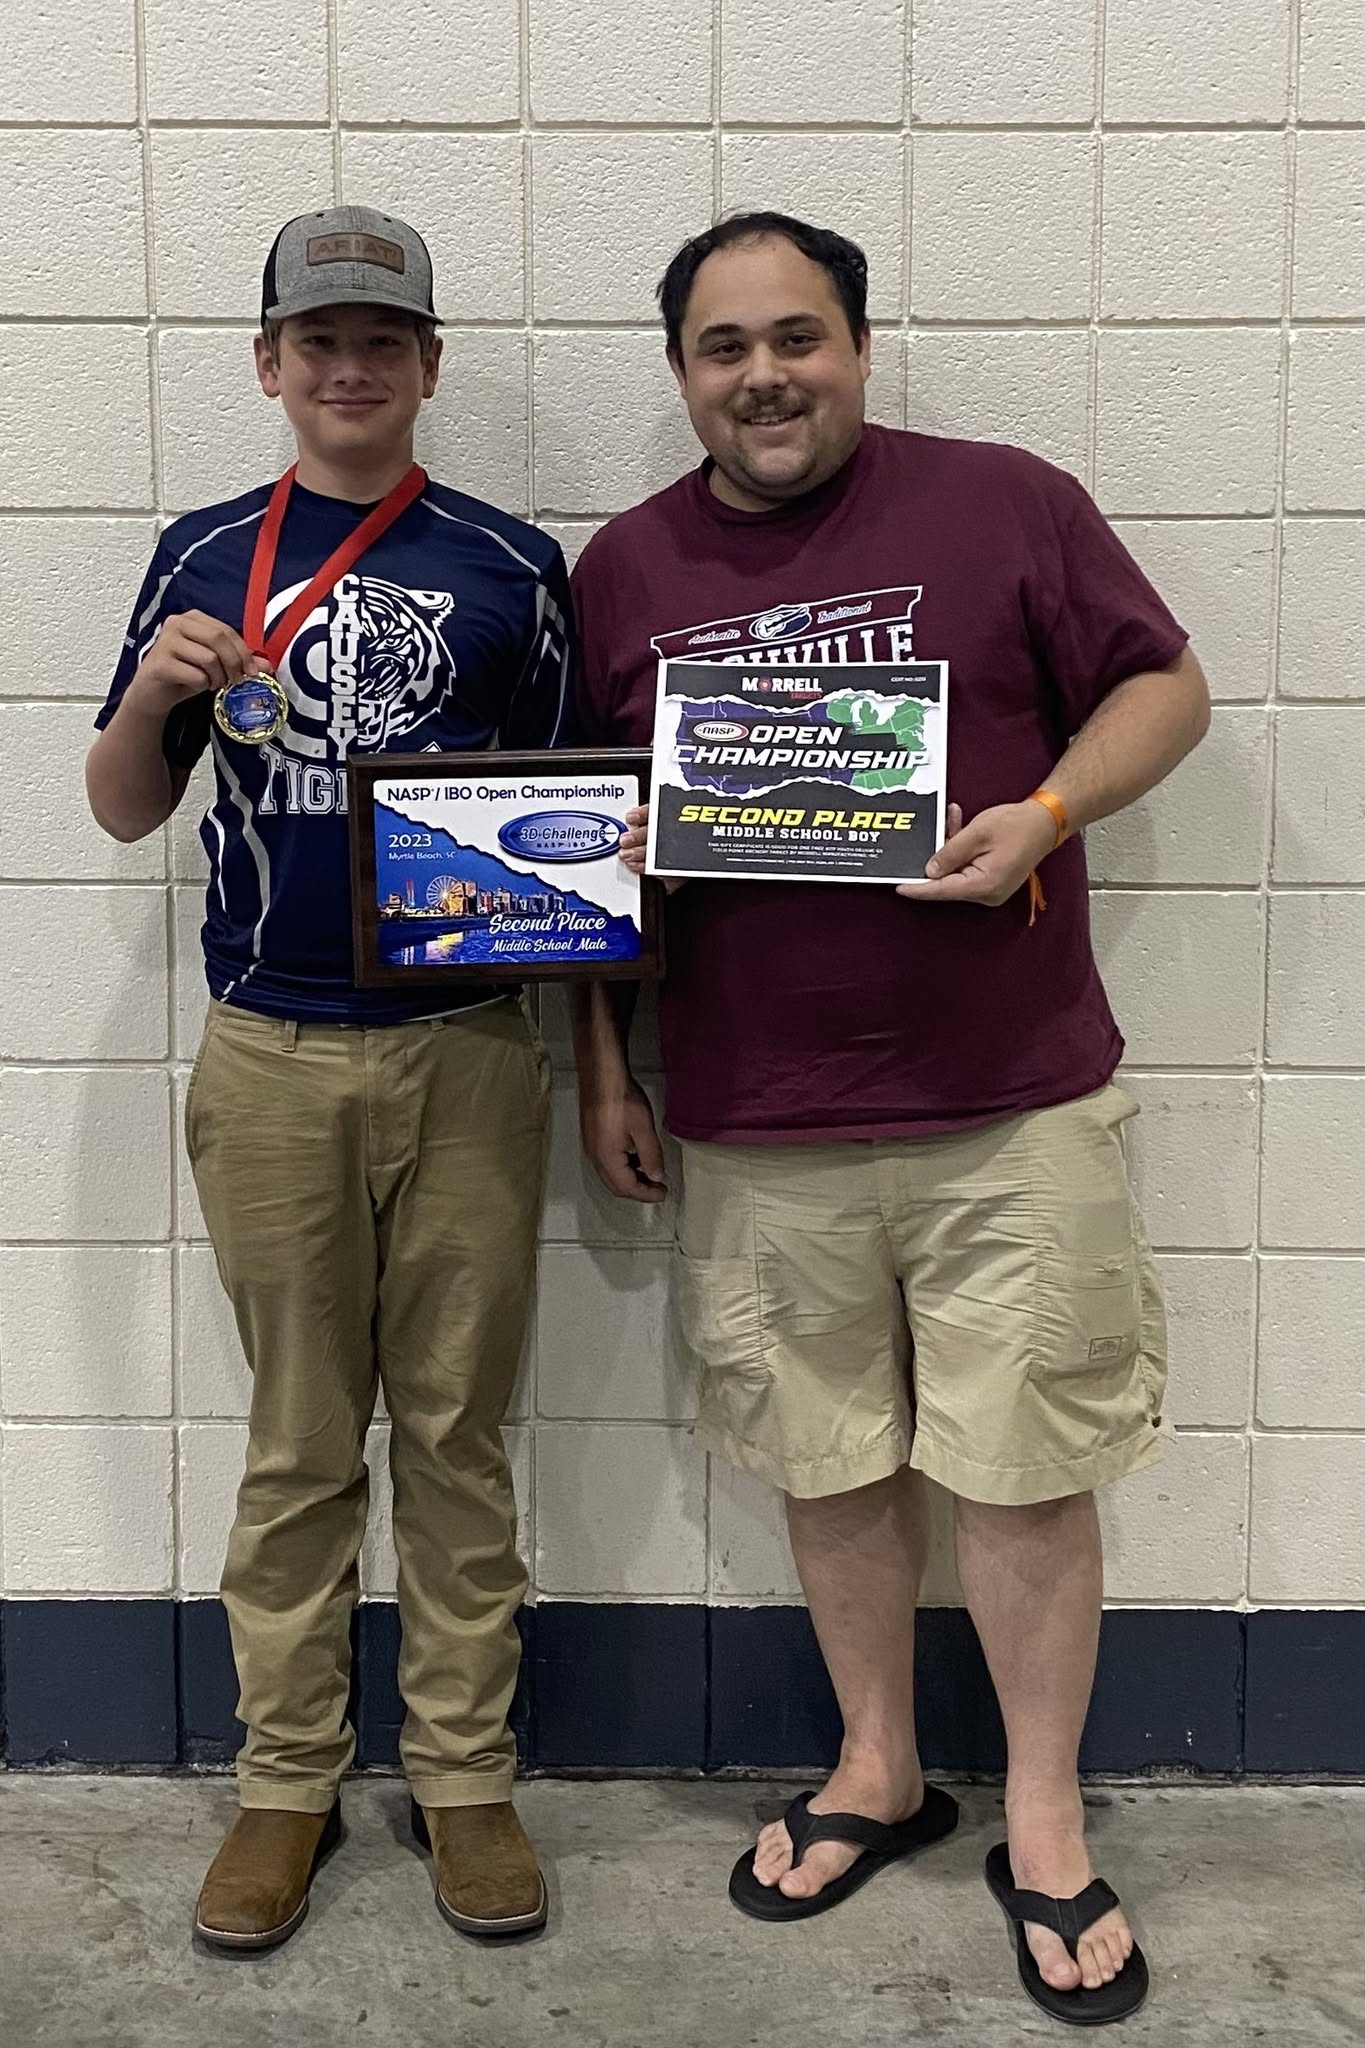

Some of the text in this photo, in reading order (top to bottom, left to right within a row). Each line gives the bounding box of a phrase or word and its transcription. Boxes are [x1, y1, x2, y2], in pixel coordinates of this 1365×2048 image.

[687, 628, 742, 645] Authentic
[817, 600, 873, 623] Traditional
[327, 573, 364, 760] CAUSEY
[742, 676, 823, 692] MORRELL
[701, 724, 843, 745] NASP OPEN
[671, 745, 930, 769] CHAMPIONSHIP
[444, 786, 472, 800] IBO
[476, 786, 517, 802] Open
[520, 784, 625, 800] Championship
[678, 805, 917, 830] SECOND PLACE
[388, 833, 432, 848] 2023
[521, 826, 606, 842] 3D Challenge
[712, 826, 881, 843] MIDDLE SCHOOL BOY
[388, 852, 415, 861] Myrtle
[488, 911, 607, 935] Second Place
[488, 937, 608, 954] Middle School Male
